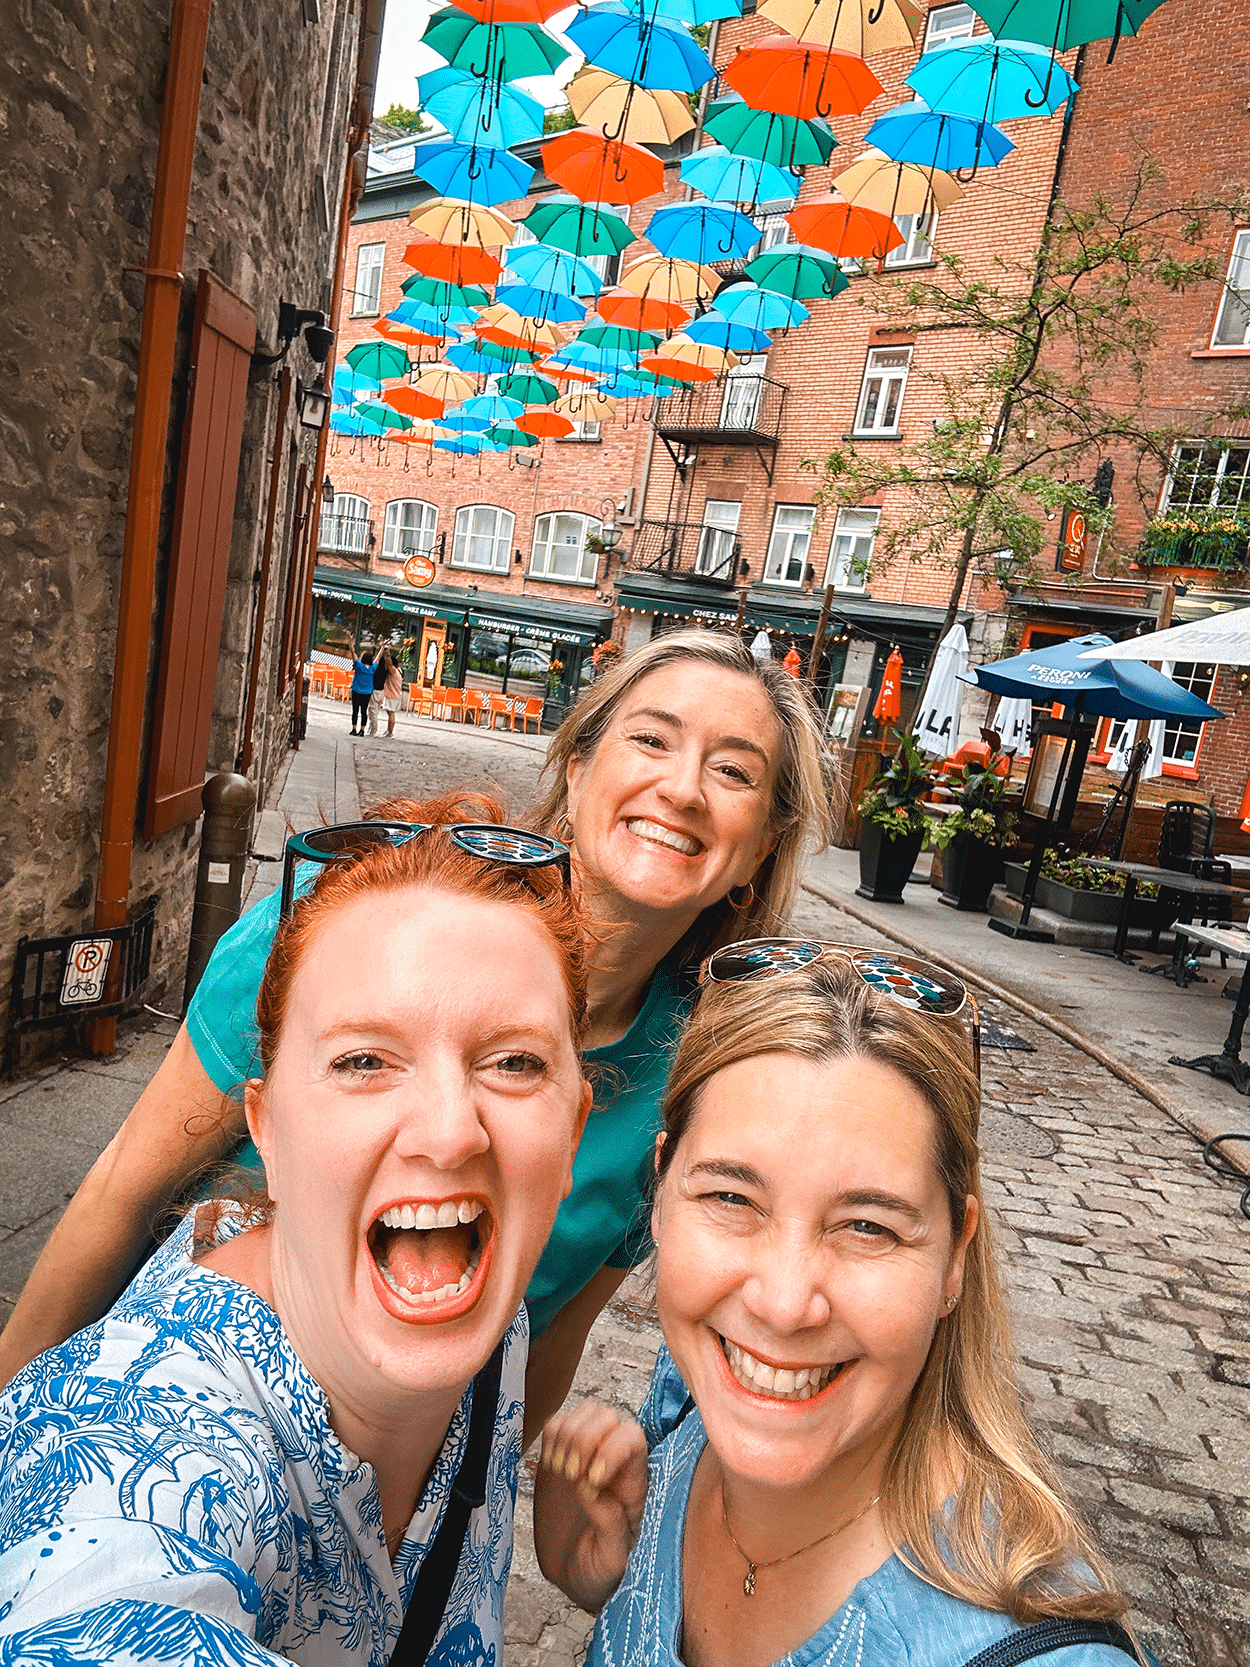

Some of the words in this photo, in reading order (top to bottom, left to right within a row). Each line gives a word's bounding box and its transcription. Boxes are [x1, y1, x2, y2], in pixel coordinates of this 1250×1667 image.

[409, 563, 432, 579] Samy
[403, 605, 419, 614] CHEZ
[420, 608, 438, 617] SAMY
[693, 609, 717, 618] CHEZ
[478, 619, 520, 631] HAMBURGER
[526, 627, 550, 638] CRÈME
[552, 633, 580, 643] GLACÉE
[1026, 663, 1092, 679] PERONI
